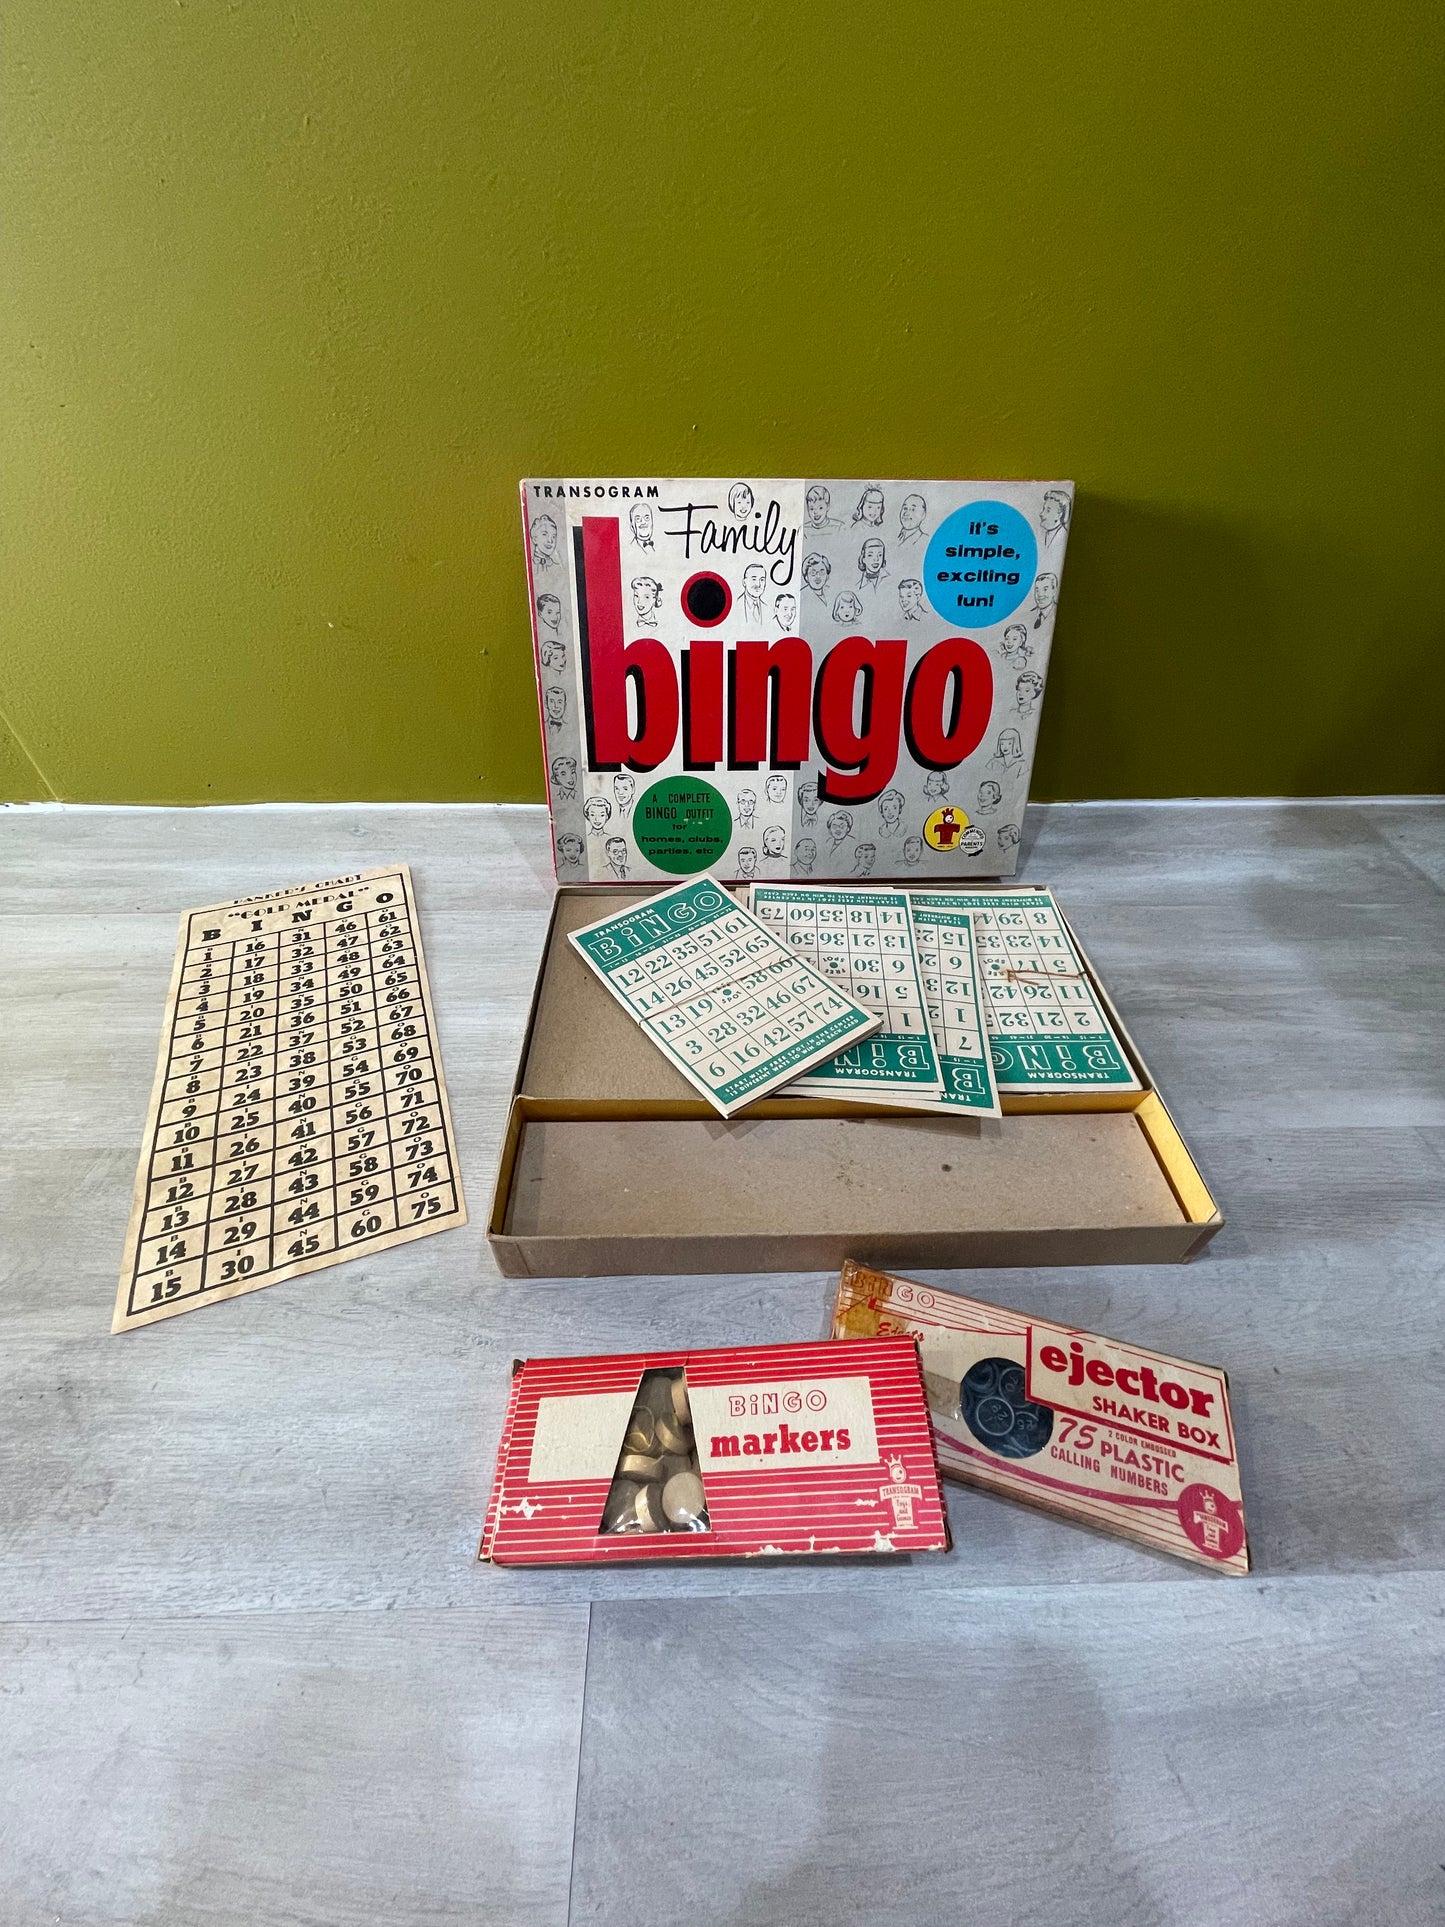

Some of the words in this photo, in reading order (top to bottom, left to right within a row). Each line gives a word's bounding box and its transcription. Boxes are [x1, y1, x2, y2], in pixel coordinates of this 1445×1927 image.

[533, 485, 660, 498] TRANSOGRAM
[969, 521, 999, 536] it's
[657, 499, 798, 587] Family
[944, 544, 1021, 561] simple,
[936, 569, 1021, 586] exciting
[956, 593, 995, 608] fun!
[572, 515, 994, 806] bingo
[651, 793, 658, 804] A
[667, 792, 712, 804] COMPLETE
[645, 806, 678, 820] BINGO
[685, 808, 715, 820] OUTFIT
[672, 823, 688, 831] for
[640, 835, 686, 844] homes,
[687, 835, 724, 844] clubs,
[648, 847, 693, 856] parties,
[695, 847, 714, 855] etc
[202, 929, 221, 942] B
[252, 920, 262, 932] I
[292, 910, 312, 923] N
[336, 901, 352, 912] G
[376, 893, 393, 903] O
[760, 907, 784, 920] 75
[790, 908, 815, 921] 60
[819, 910, 844, 922] 35
[850, 911, 873, 923] 18
[880, 911, 905, 924] 14
[998, 912, 1024, 925] 29
[1033, 912, 1048, 925] 8
[593, 908, 656, 938] TRANSOGRAM
[790, 932, 815, 945] 59
[819, 932, 845, 946] 36
[852, 934, 875, 947] 21
[884, 935, 907, 949] 13
[1006, 935, 1032, 948] 23
[1036, 935, 1064, 948] 14
[617, 970, 644, 989] 12
[646, 955, 672, 974] 22
[672, 940, 699, 961] 35
[698, 929, 724, 950] 51
[725, 917, 750, 935] 61
[635, 991, 665, 1011] 14
[665, 975, 692, 996] 26
[694, 961, 720, 983] 45
[718, 948, 746, 969] 52
[746, 935, 770, 955] 65
[854, 958, 880, 973] 30
[1053, 959, 1067, 973] 5
[856, 984, 881, 999] 16
[895, 985, 908, 999] 5
[990, 985, 1018, 999] 42
[1023, 985, 1053, 999] 26
[1058, 985, 1086, 999] 11
[657, 1013, 686, 1034] 13
[686, 998, 713, 1020] 19
[741, 970, 768, 990] 58
[686, 1039, 702, 1055] 3
[709, 1021, 738, 1043] 28
[736, 1005, 766, 1026] 32
[765, 989, 792, 1010] 46
[791, 975, 816, 995] 67
[901, 1012, 912, 1028] 1
[1000, 1012, 1029, 1027] 32
[1034, 1012, 1063, 1027] 21
[1074, 1012, 1091, 1027] 2
[709, 1062, 726, 1078] 6
[730, 1043, 760, 1065] 16
[761, 1026, 791, 1048] 42
[787, 1010, 815, 1032] 57
[813, 996, 843, 1016] 74
[725, 1078, 748, 1093] START
[748, 1066, 769, 1079] WITH
[830, 1015, 855, 1031] CENTER
[739, 1071, 771, 1091] DIFFERENT
[772, 1060, 790, 1072] WAYS
[791, 1053, 801, 1061] TO
[801, 1045, 815, 1055] WIN
[826, 1029, 843, 1039] EACH
[843, 1018, 859, 1029] CARD
[834, 1067, 917, 1078] TRANSOGRAM
[182, 1105, 196, 1118] 9
[233, 1088, 260, 1106] 24
[289, 1075, 315, 1091] 39
[343, 1060, 369, 1077] 54
[394, 1047, 418, 1062] 69
[174, 1126, 200, 1144] 10
[231, 1111, 259, 1130] 25
[289, 1097, 316, 1114] 40
[345, 1082, 370, 1099] 55
[396, 1068, 422, 1085] 70
[172, 1153, 194, 1172] 11
[230, 1138, 259, 1157] 26
[291, 1122, 316, 1139] 41
[346, 1106, 372, 1124] 56
[401, 1091, 424, 1108] 71
[166, 1183, 193, 1203] 12
[227, 1164, 259, 1185] 27
[288, 1148, 318, 1166] 42
[348, 1131, 374, 1151] 57
[402, 1116, 430, 1134] 72
[161, 1211, 189, 1232] 13
[225, 1192, 257, 1213] 28
[289, 1174, 318, 1194] 43
[350, 1157, 378, 1177] 58
[406, 1141, 433, 1160] 73
[156, 1240, 186, 1265] 14
[224, 1222, 256, 1245] 29
[288, 1202, 319, 1224] 44
[351, 1185, 379, 1206] 59
[408, 1166, 438, 1188] 74
[151, 1276, 181, 1302] 15
[221, 1256, 254, 1280] 30
[288, 1235, 319, 1257] 45
[351, 1216, 381, 1237] 60
[412, 1197, 440, 1219] 75
[1039, 1341, 1215, 1419] ejector
[1092, 1395, 1171, 1434] SHAKER
[1176, 1421, 1221, 1450] BOX
[710, 1423, 852, 1458] markers
[1057, 1416, 1099, 1450] 75
[1108, 1430, 1113, 1438] 2
[1115, 1433, 1138, 1447] COLOR
[1140, 1440, 1177, 1458] EMBOSSED
[1100, 1440, 1186, 1483] PLASTIC
[1050, 1445, 1101, 1473] CALLING
[1110, 1465, 1169, 1497] NUMBERS
[881, 1485, 920, 1498] TRANSOGRAM
